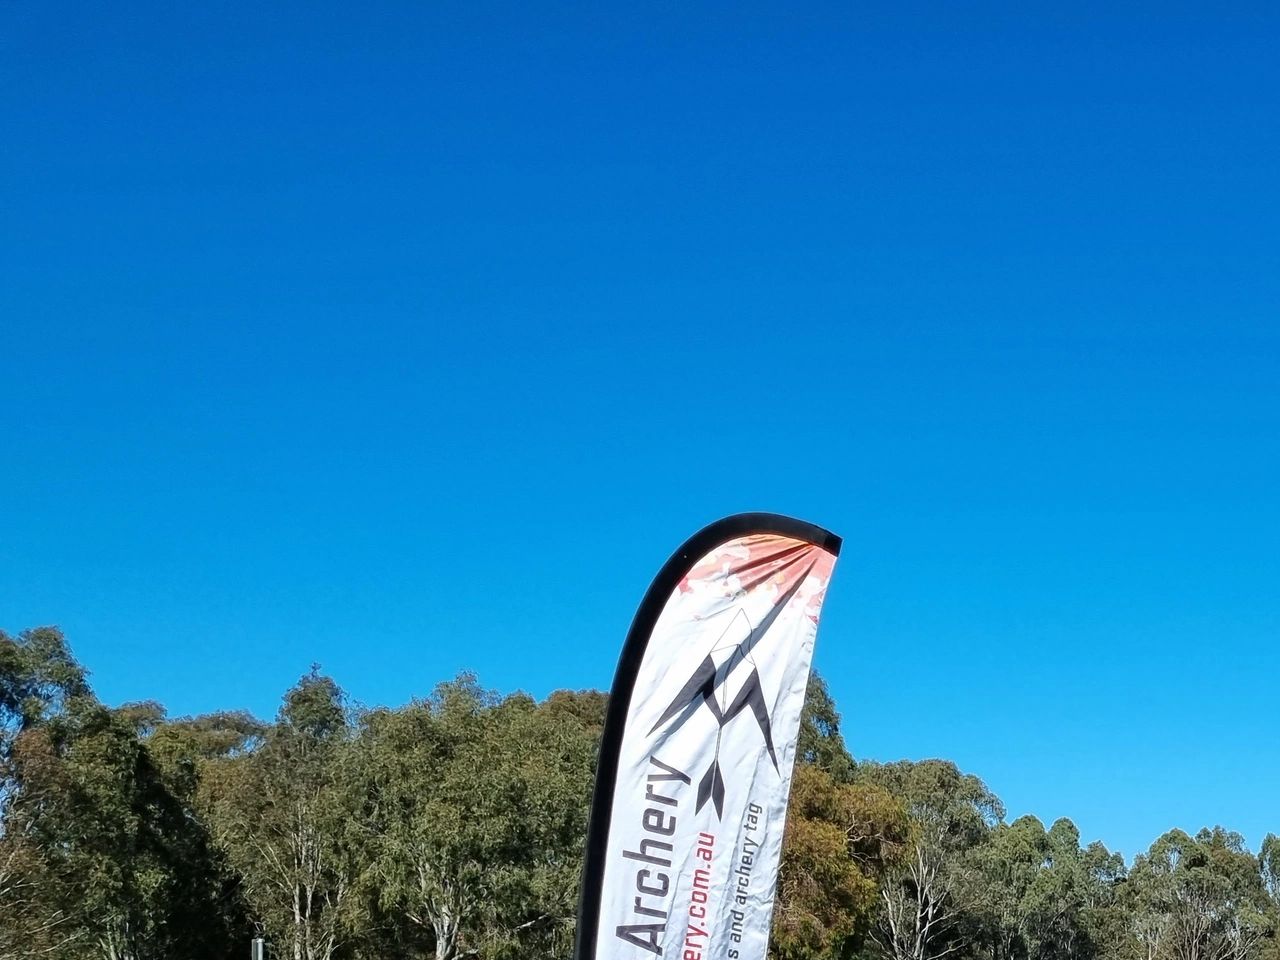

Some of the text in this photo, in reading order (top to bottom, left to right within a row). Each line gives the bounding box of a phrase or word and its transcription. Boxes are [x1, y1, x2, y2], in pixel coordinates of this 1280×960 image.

[744, 802, 763, 832] tag
[616, 756, 691, 956] Archery
[734, 837, 759, 904] archery
[729, 909, 746, 943] and
